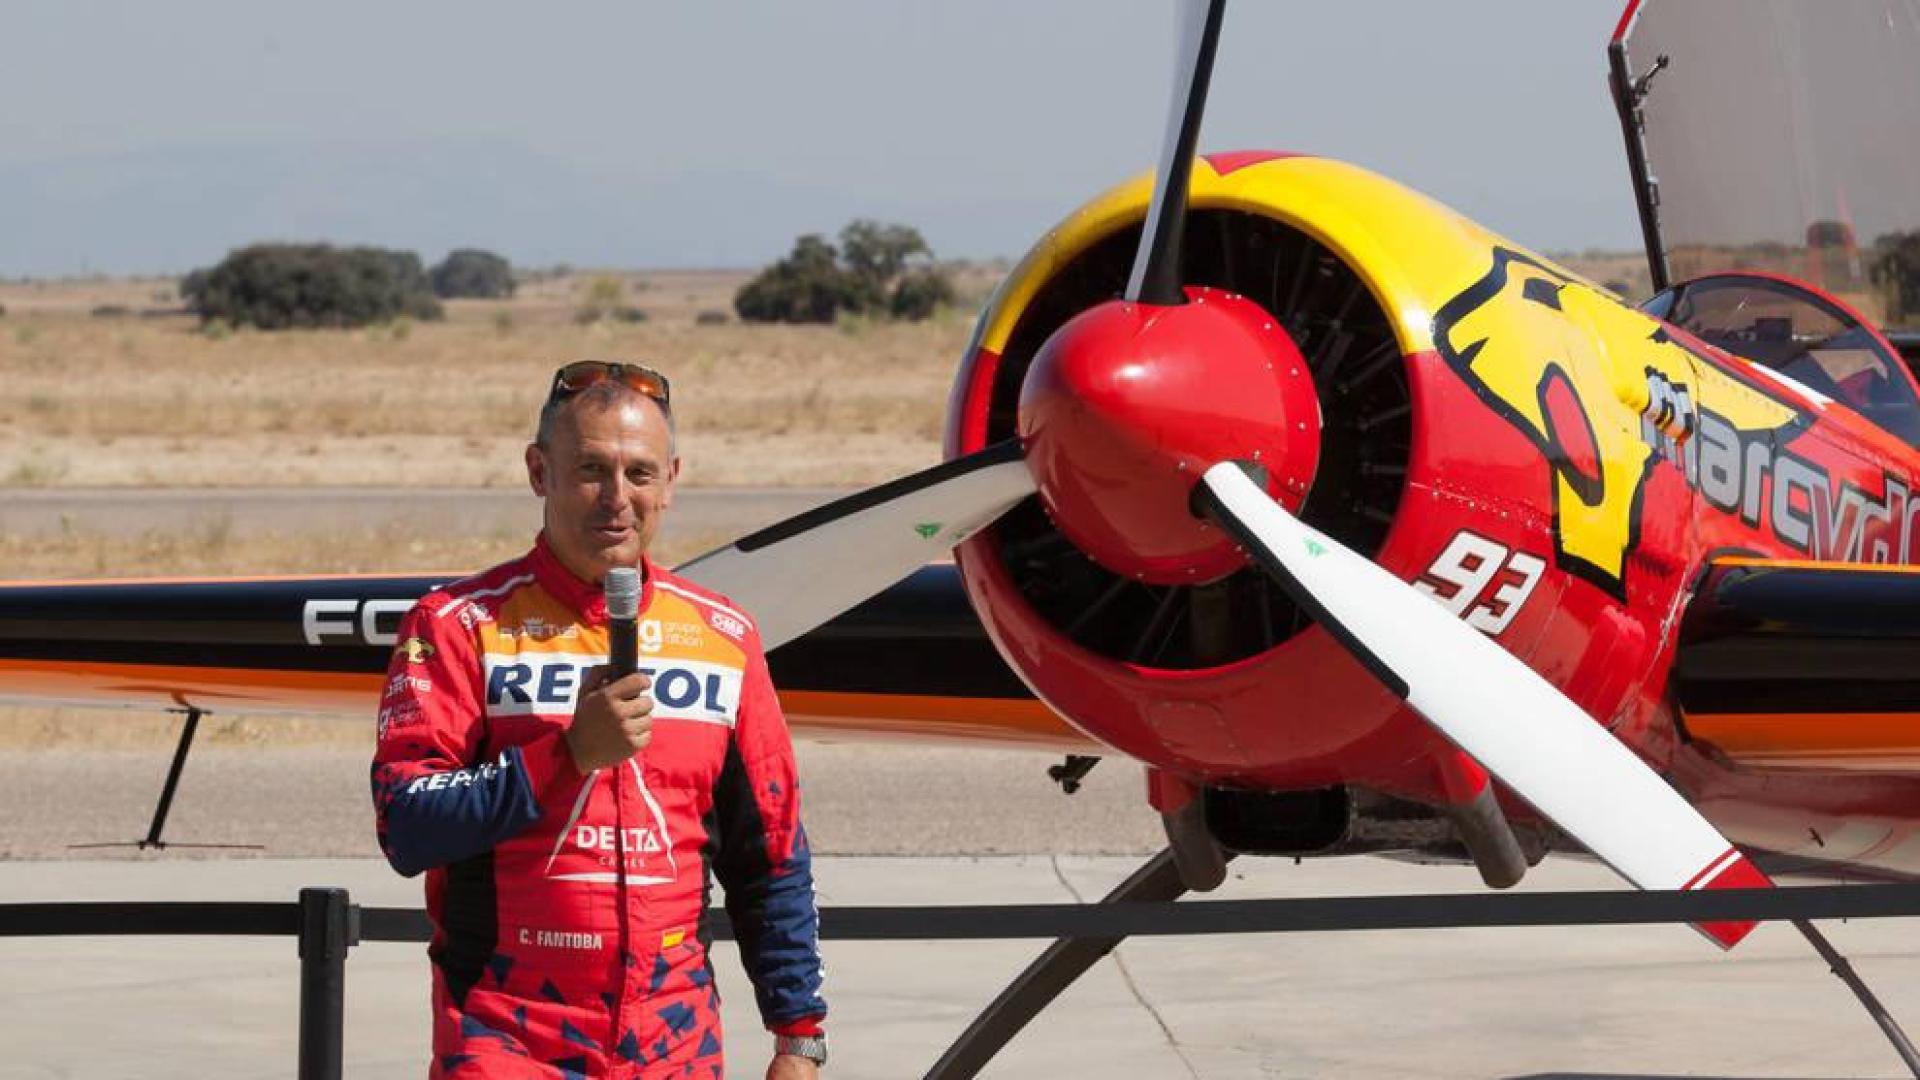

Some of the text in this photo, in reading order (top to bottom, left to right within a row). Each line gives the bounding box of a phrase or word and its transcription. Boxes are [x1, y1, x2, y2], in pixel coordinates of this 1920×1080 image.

[1408, 531, 1547, 635] 93
[487, 663, 727, 714] REOL
[576, 825, 661, 852] DELTA
[536, 930, 602, 950] FANTOBA
